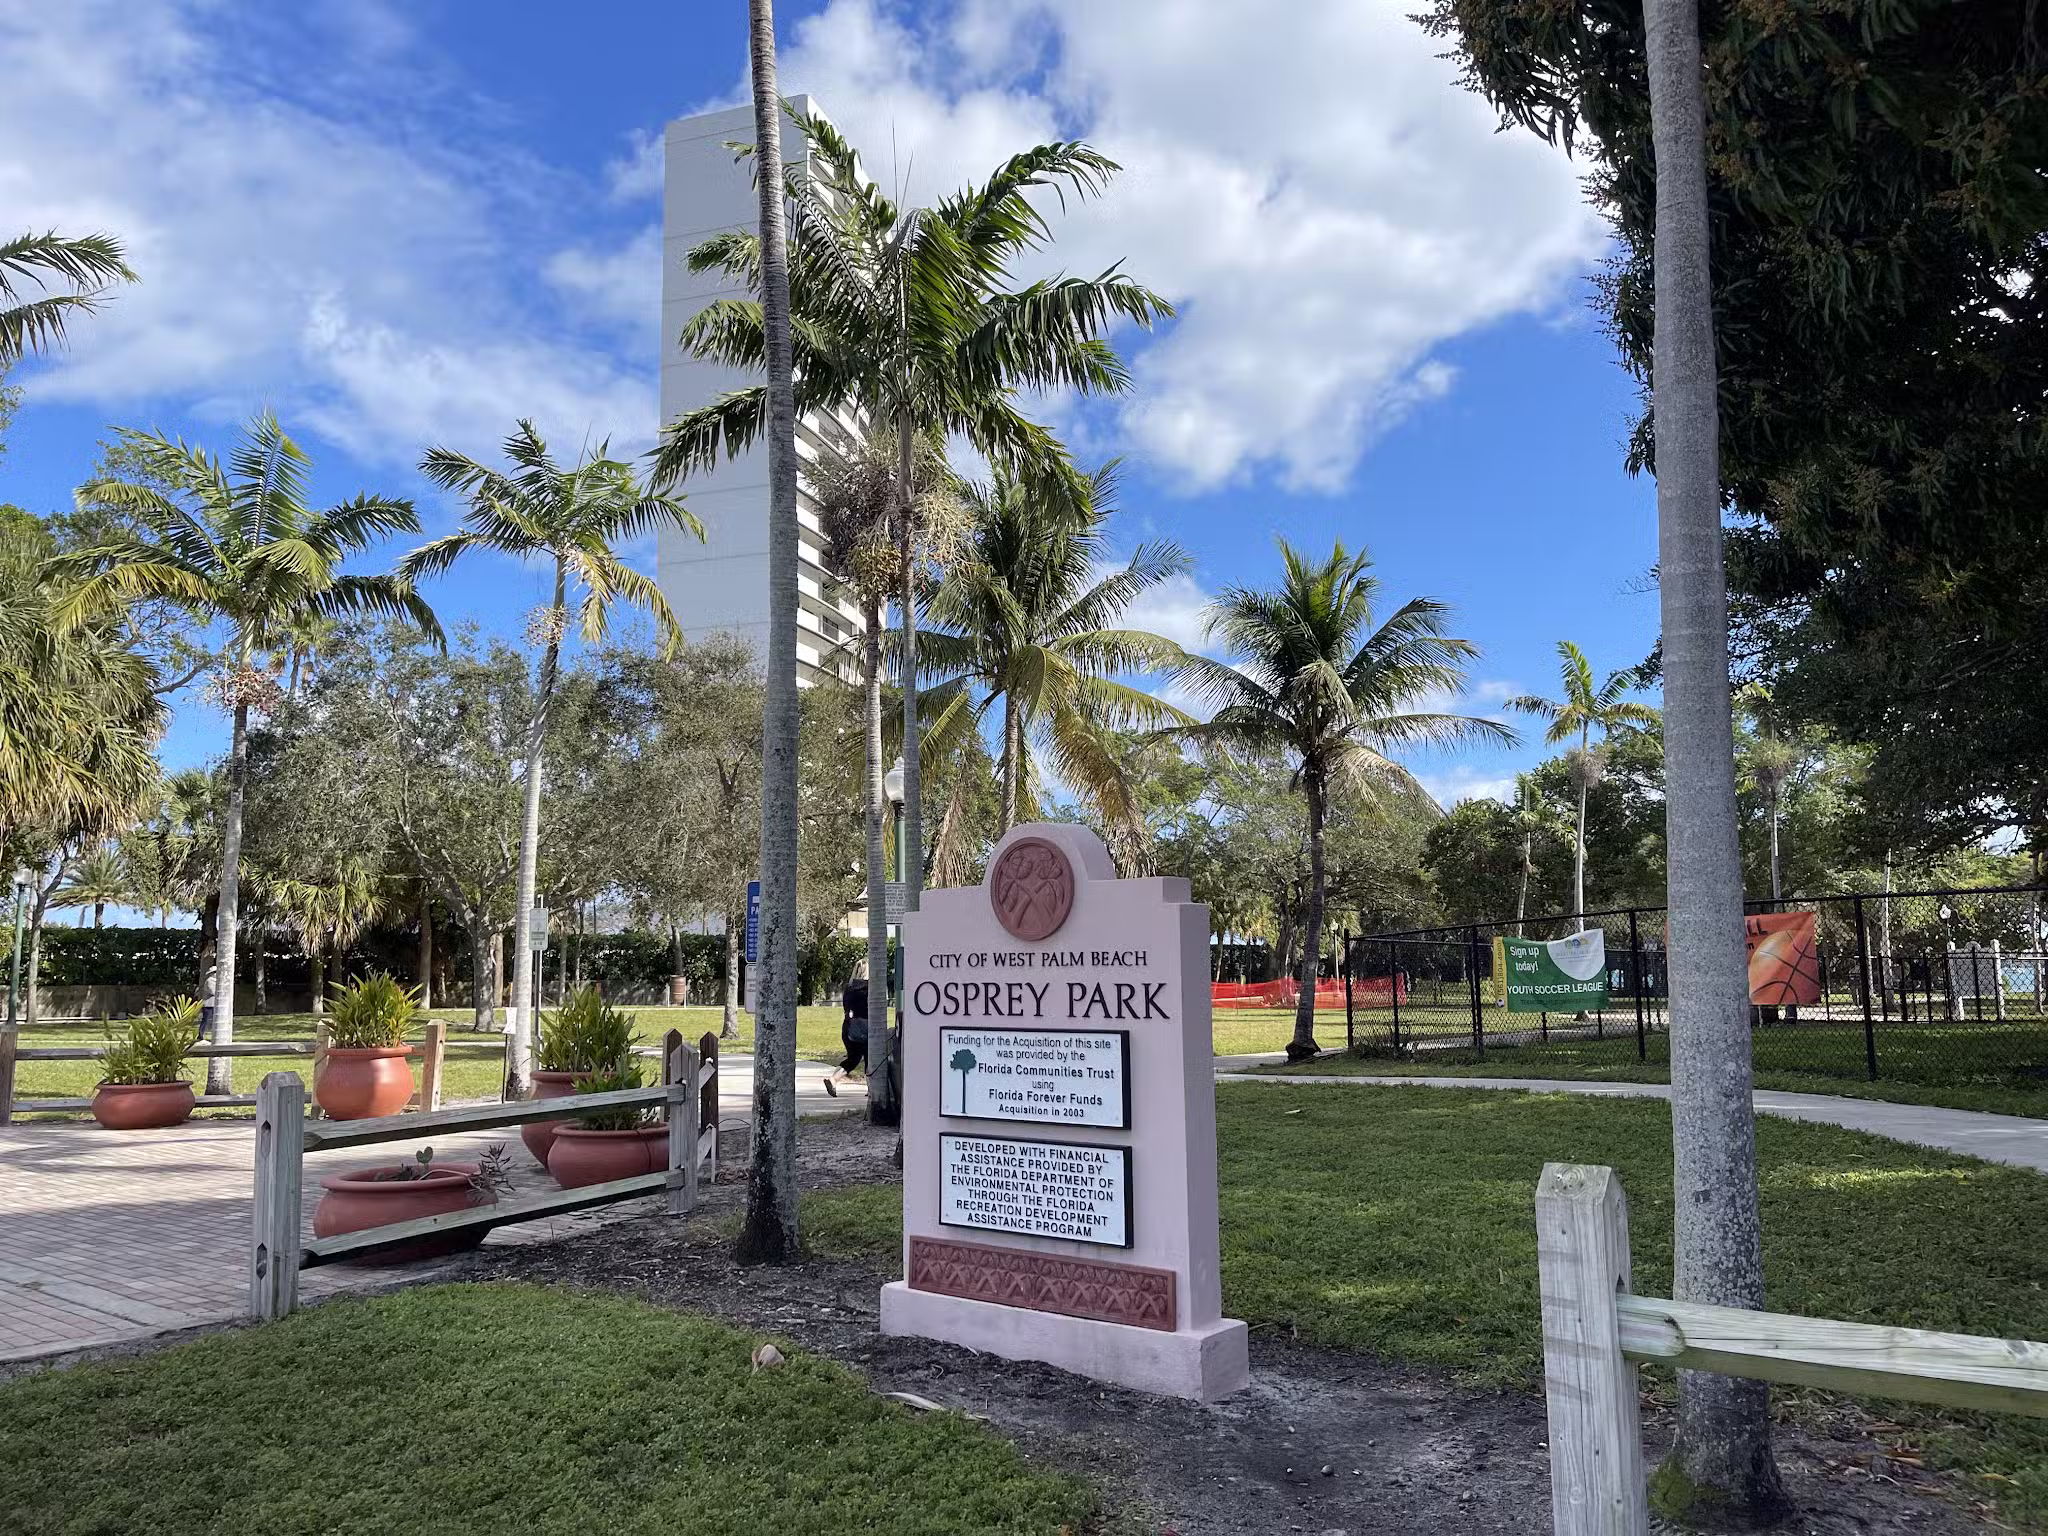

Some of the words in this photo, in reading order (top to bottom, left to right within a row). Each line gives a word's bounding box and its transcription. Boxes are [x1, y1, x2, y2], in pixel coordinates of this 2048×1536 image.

[930, 954, 962, 968] CITY
[968, 953, 987, 967] OF
[993, 952, 1035, 967] WEST
[1042, 952, 1084, 967] PALM
[1091, 951, 1147, 966] BEACH
[1510, 946, 1527, 958] Sign
[1528, 947, 1540, 958] up
[1516, 961, 1539, 973] today!
[1508, 985, 1534, 994] YOUTH
[1535, 984, 1571, 994] SOCCER
[1572, 982, 1604, 993] LEAGUE
[914, 981, 1050, 1016] OSPREY
[1066, 982, 1170, 1019] PARK
[948, 1034, 981, 1047] Funding
[984, 1035, 994, 1046] for
[997, 1036, 1010, 1046] the
[1013, 1036, 1060, 1049] Acquisition
[1064, 1037, 1072, 1048] of
[1076, 1038, 1092, 1049] this
[1095, 1039, 1111, 1049] site
[996, 1050, 1014, 1059] was
[1016, 1049, 1054, 1060] provided
[1057, 1050, 1068, 1062] by
[1071, 1050, 1085, 1061] the
[978, 1063, 1012, 1075] Florida
[1016, 1064, 1083, 1078] Communities
[1087, 1067, 1115, 1079] Trust
[1032, 1079, 1054, 1092] using
[989, 1088, 1023, 1101] Florida
[1027, 1090, 1066, 1103] Forever
[1070, 1093, 1103, 1106] Funds
[999, 1104, 1048, 1115] Acquisition
[1052, 1107, 1060, 1116] in
[1064, 1108, 1084, 1118] 2003
[955, 1141, 1016, 1155] DEVELOPED
[1020, 1146, 1046, 1158] WITH
[1050, 1149, 1109, 1164] FINANCIAL
[960, 1153, 1025, 1168] ASSISTANCE
[1028, 1160, 1084, 1173] PROVIDED
[1088, 1164, 1103, 1175] BY
[951, 1164, 970, 1174] THE
[974, 1166, 1018, 1179] FLORIDA
[1022, 1171, 1095, 1186] DEPARTMENT
[1099, 1178, 1114, 1188] OF
[952, 1176, 1038, 1193] ENVIRONMENTAL
[1042, 1185, 1113, 1202] PROTECTION
[968, 1189, 1018, 1203] THROUGH
[1022, 1195, 1043, 1206] THE
[1047, 1198, 1095, 1212] FLORIDA
[957, 1200, 1022, 1216] RECREATION
[1026, 1208, 1108, 1226] DEVELOPMENT
[968, 1213, 1032, 1230] ASSISTANCE
[1036, 1221, 1092, 1237] PROGRAM
